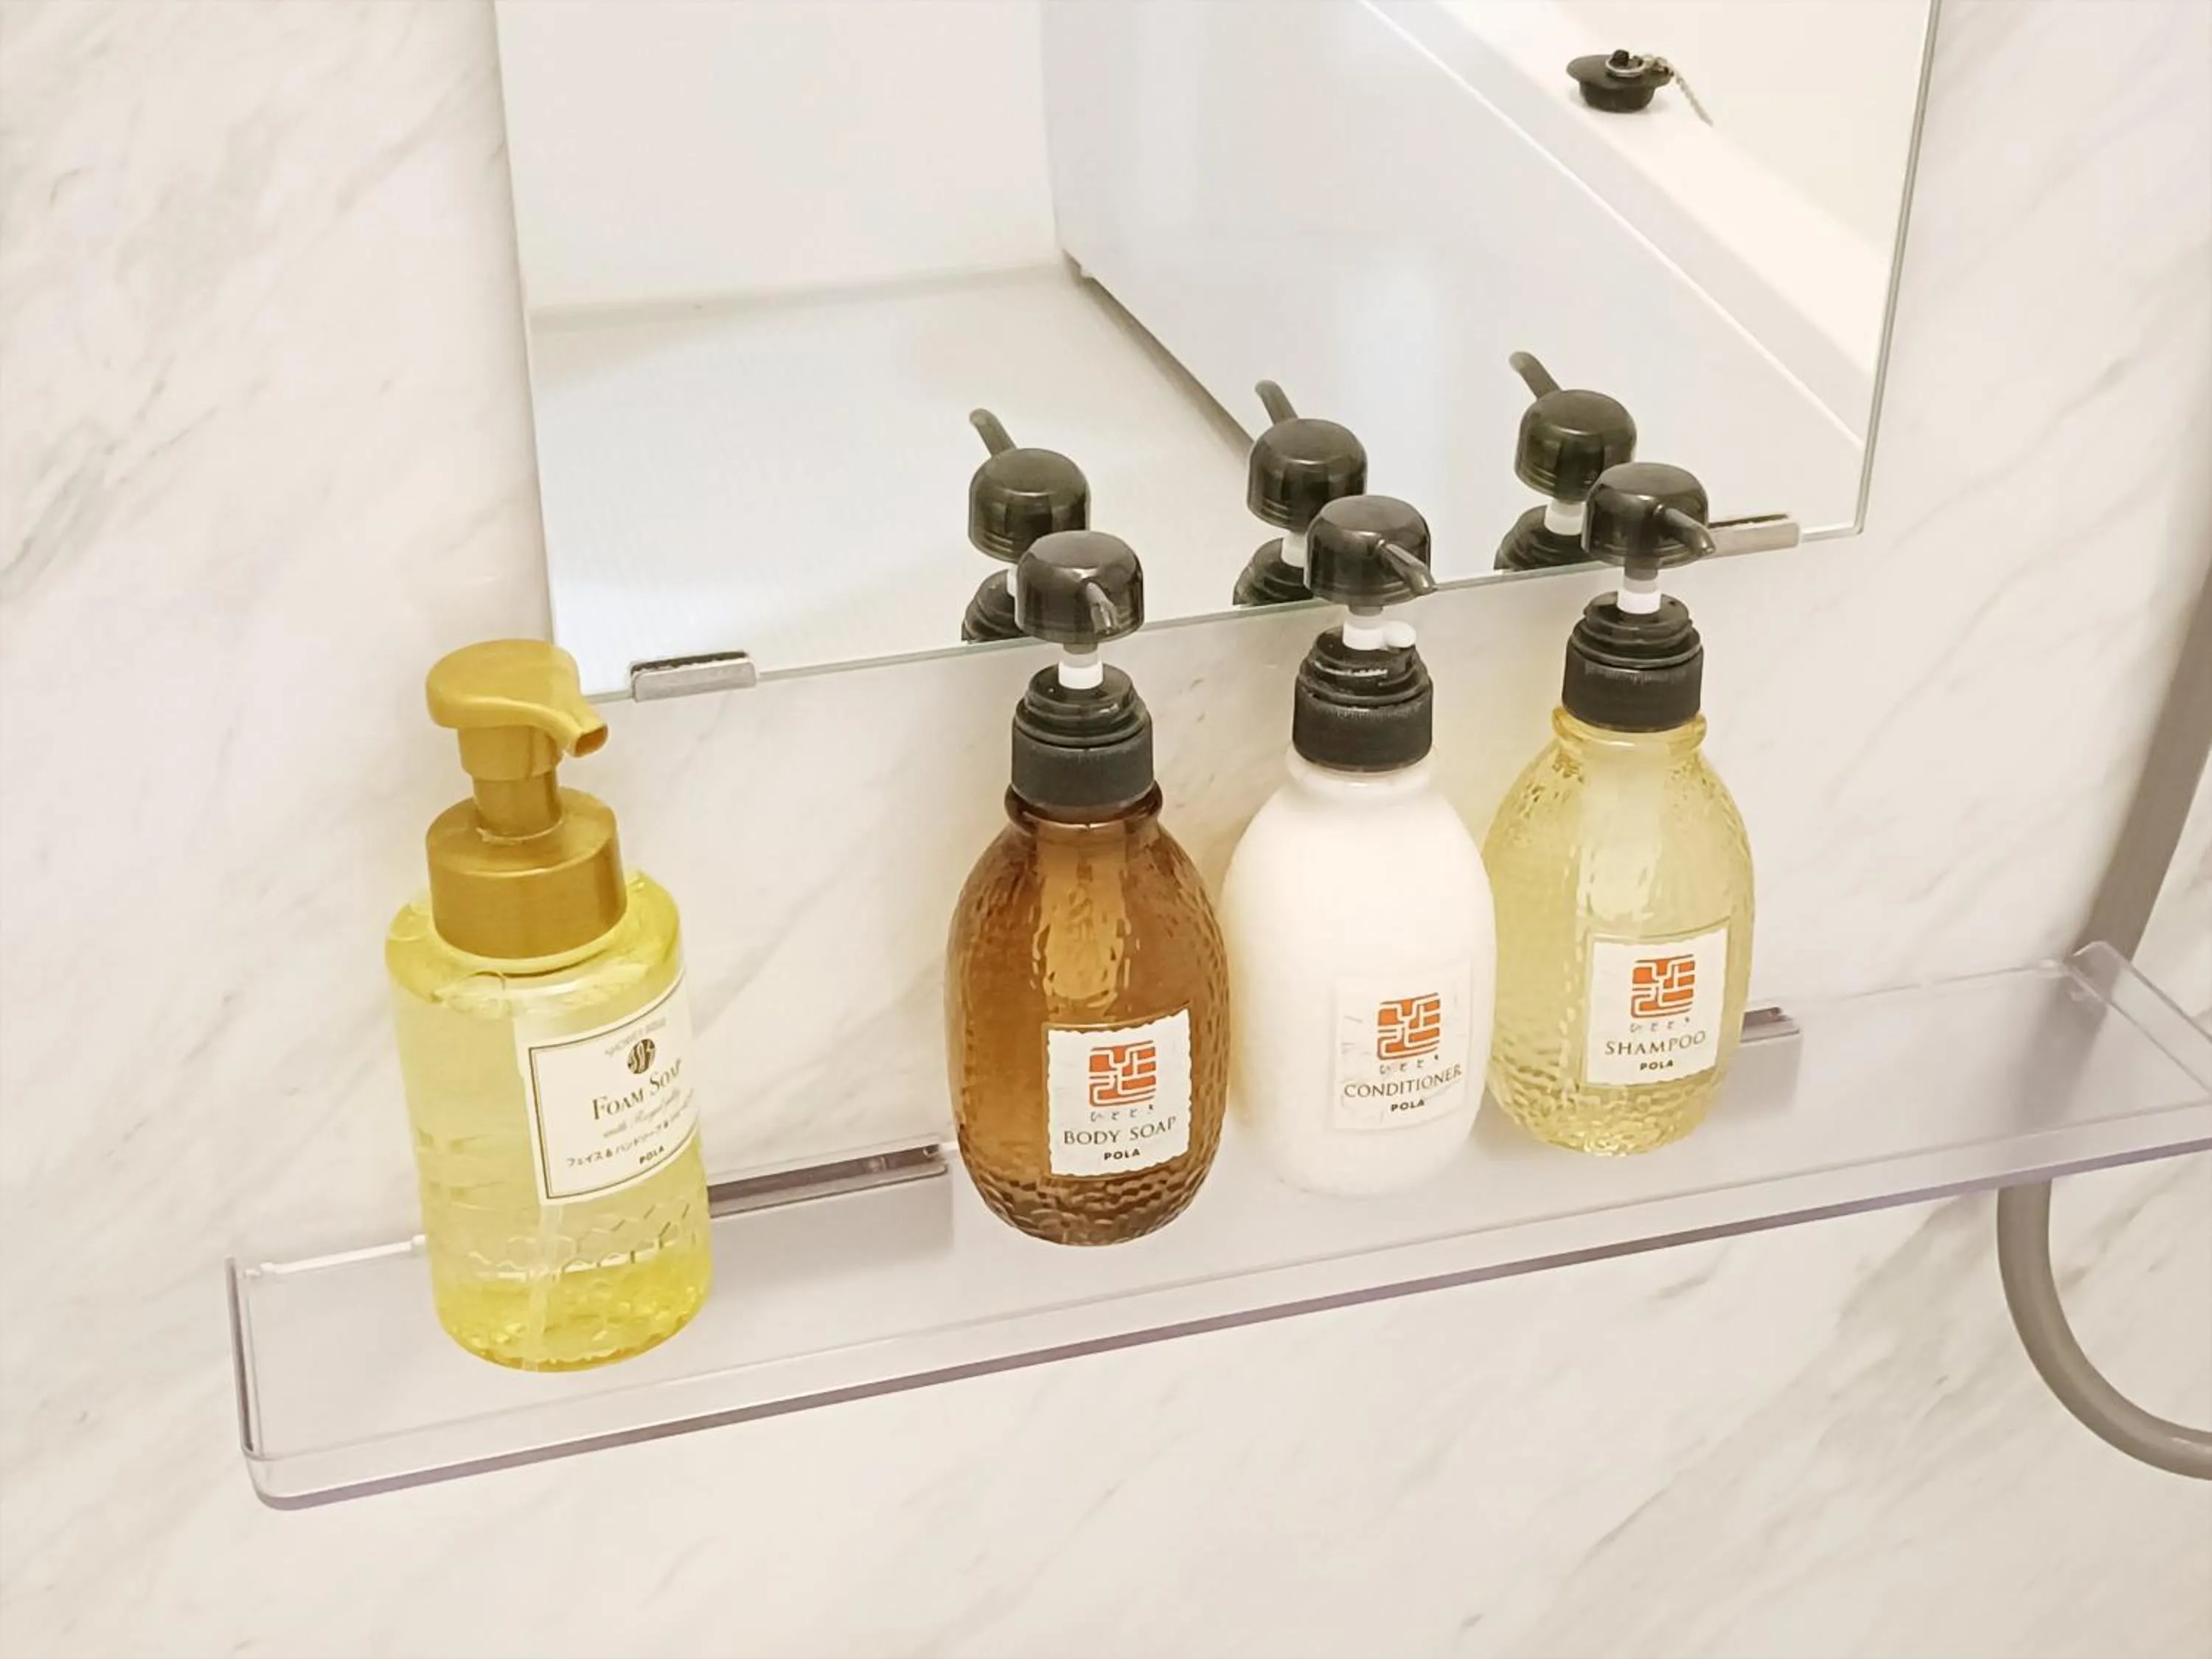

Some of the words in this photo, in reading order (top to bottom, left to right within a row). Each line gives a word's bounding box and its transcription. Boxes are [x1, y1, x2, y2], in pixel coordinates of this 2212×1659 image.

[1605, 1030, 1706, 1056] SHAMPOO
[1639, 1060, 1674, 1071] POLA
[1343, 1062, 1463, 1098] CONDITIONER
[591, 1094, 645, 1121] FOAM
[1391, 1099, 1425, 1112] POLA
[1063, 1130, 1121, 1145] BODY
[1129, 1115, 1178, 1141] SOAP
[639, 1144, 666, 1165] POLA
[1103, 1148, 1141, 1161] POLA
